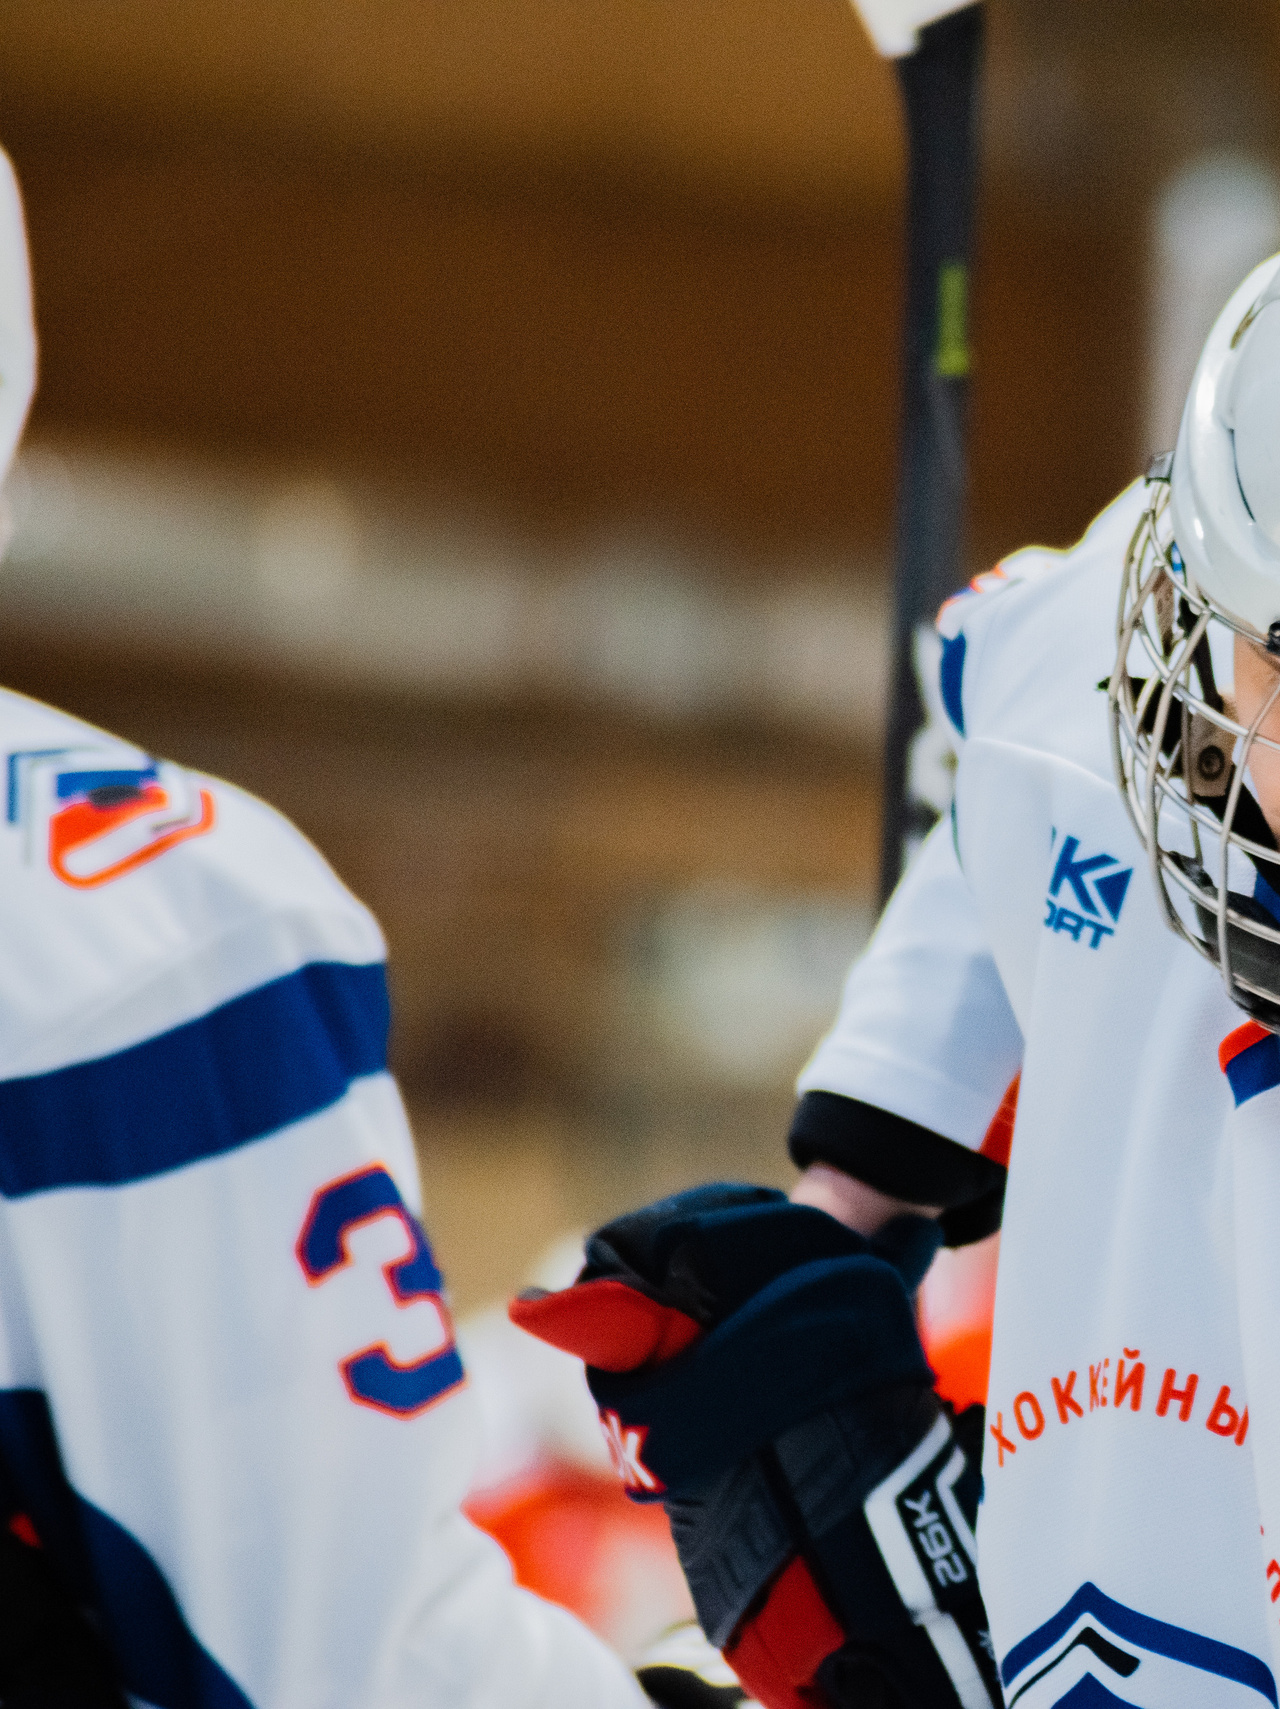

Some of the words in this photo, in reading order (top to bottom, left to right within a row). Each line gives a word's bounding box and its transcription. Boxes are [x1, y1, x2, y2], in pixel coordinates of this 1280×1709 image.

[1050, 825, 1103, 918] K
[295, 1158, 470, 1421] 3
[905, 1489, 968, 1587] 26K
